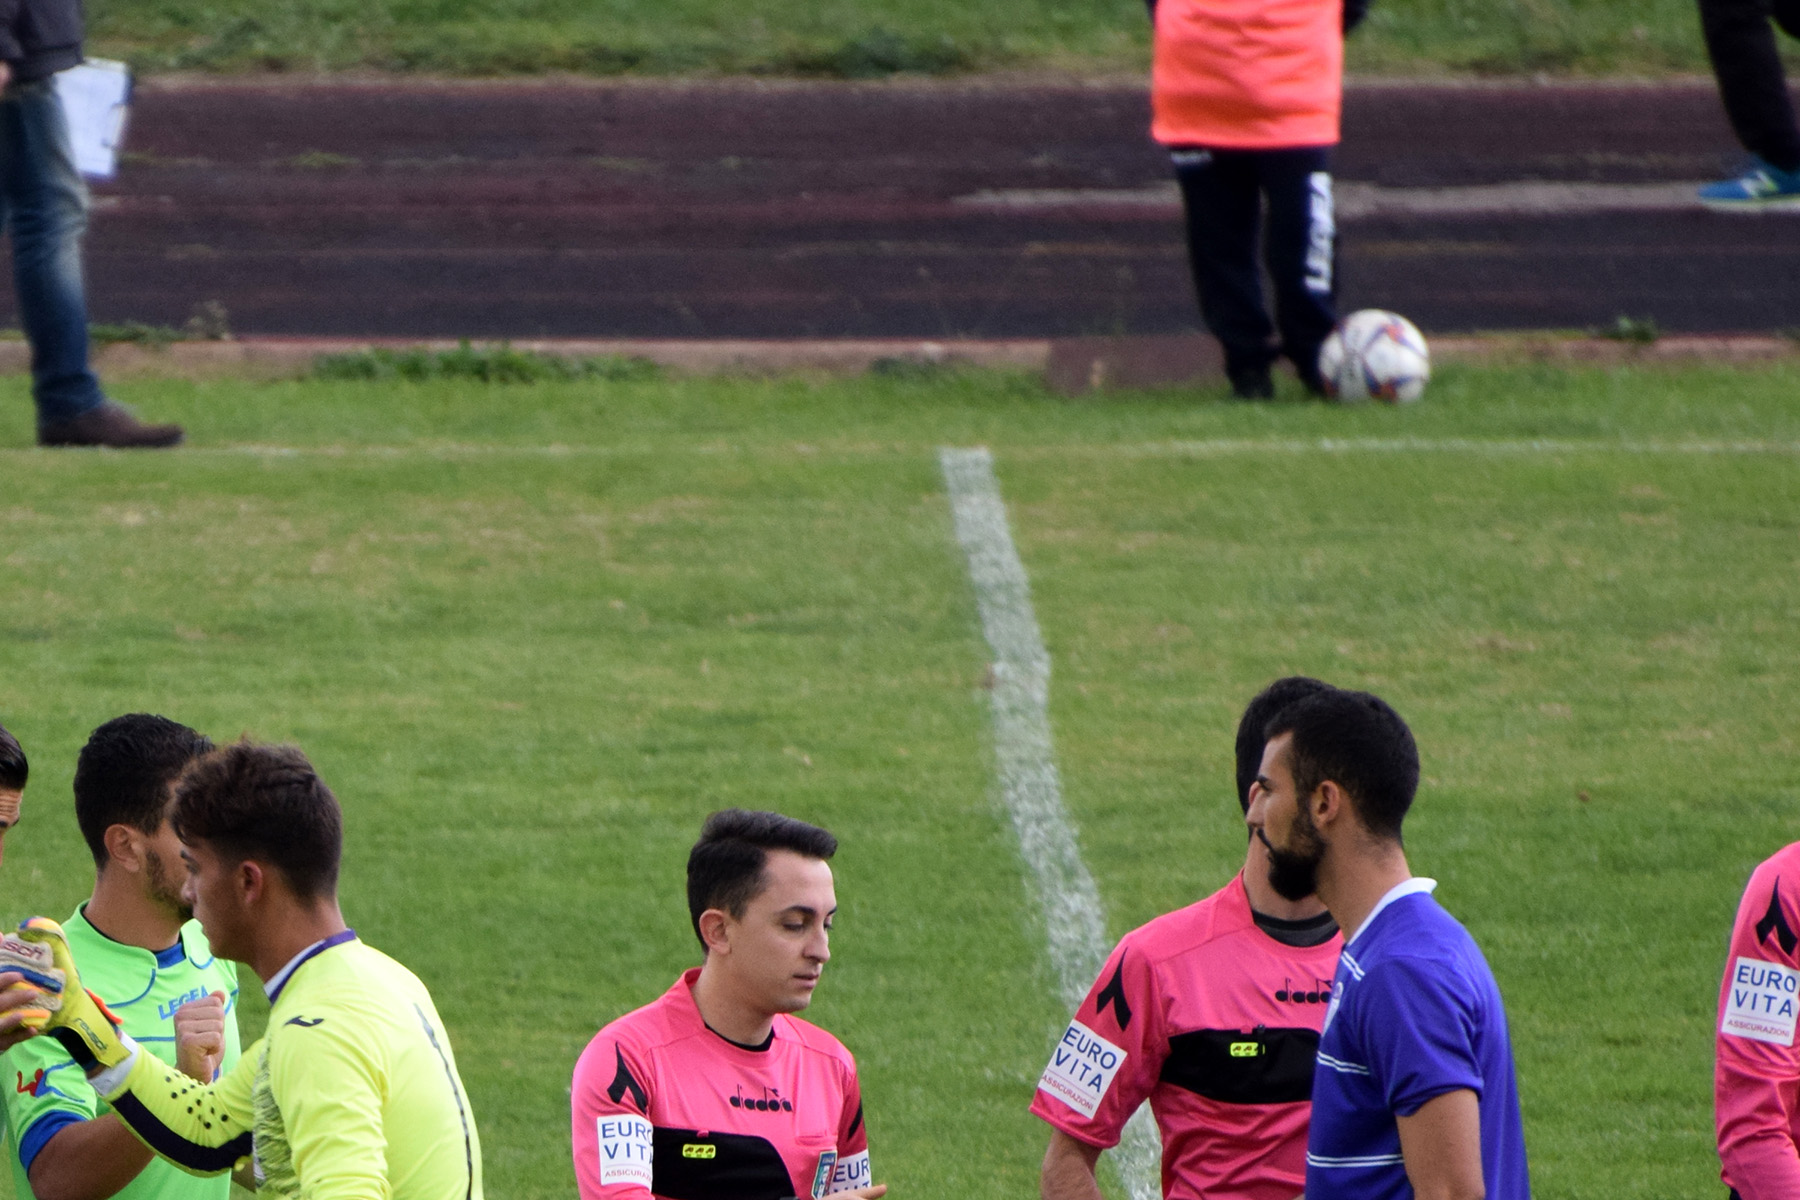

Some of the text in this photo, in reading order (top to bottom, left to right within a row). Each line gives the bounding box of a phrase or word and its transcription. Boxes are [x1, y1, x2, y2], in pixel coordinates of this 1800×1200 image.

[1737, 964, 1797, 993] EURO
[1734, 989, 1794, 1018] VITA
[1726, 1018, 1790, 1038] ASSICURAZIONI
[1062, 1026, 1117, 1070] EURO
[1055, 1047, 1103, 1094] VITA
[729, 1084, 793, 1114] diadora
[1042, 1074, 1094, 1111] ASSICURAZIONI
